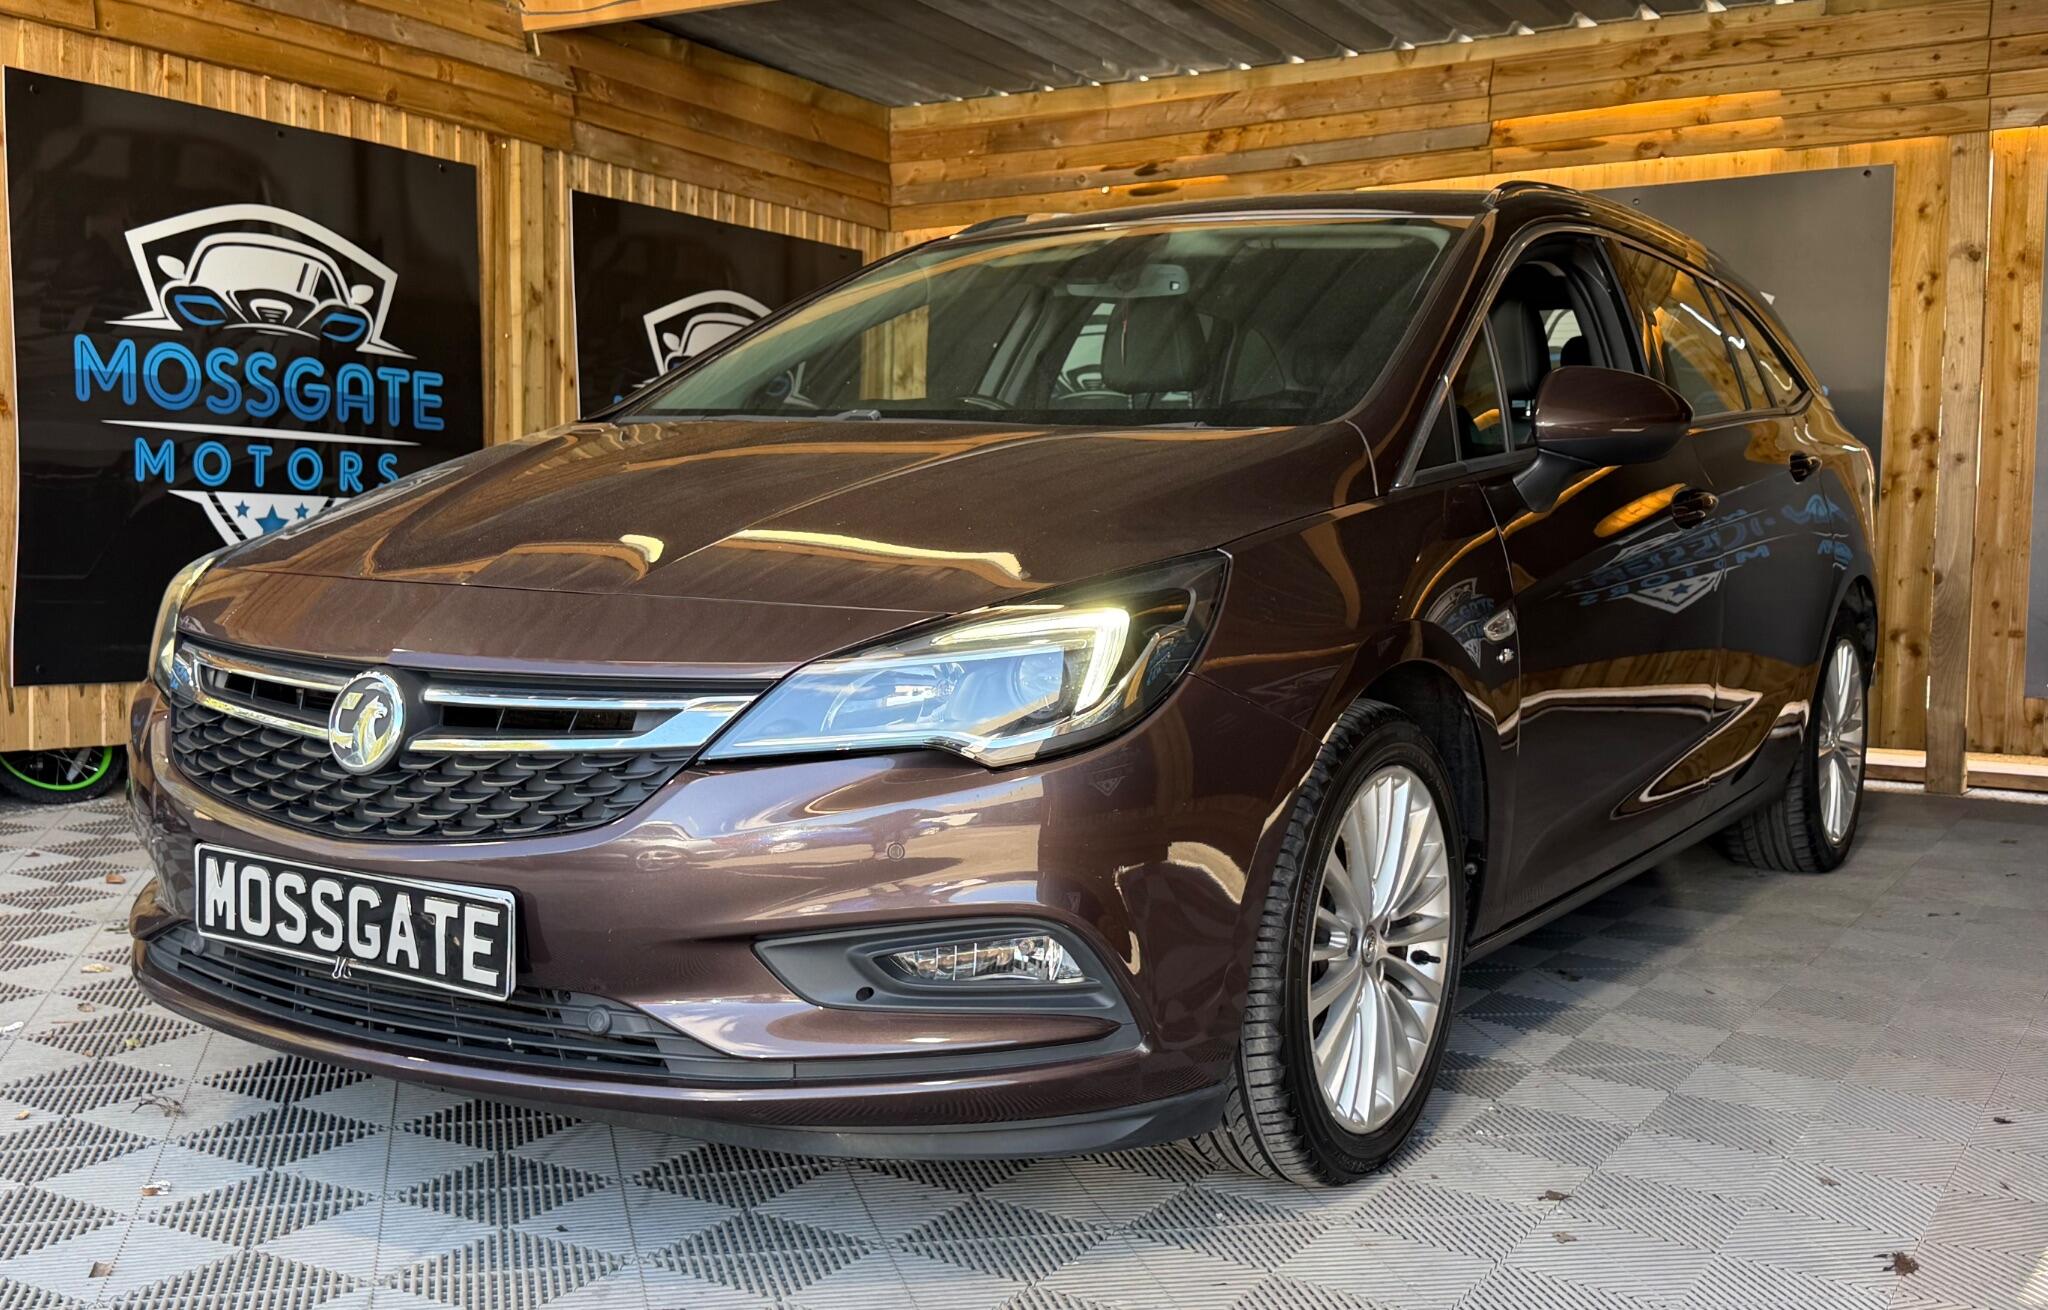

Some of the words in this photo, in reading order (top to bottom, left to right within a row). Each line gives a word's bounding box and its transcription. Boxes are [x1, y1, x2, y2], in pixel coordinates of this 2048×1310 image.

[73, 333, 445, 431] MOSSGATE
[134, 437, 399, 493] MOTORS
[204, 856, 501, 987] MOSSGATE
